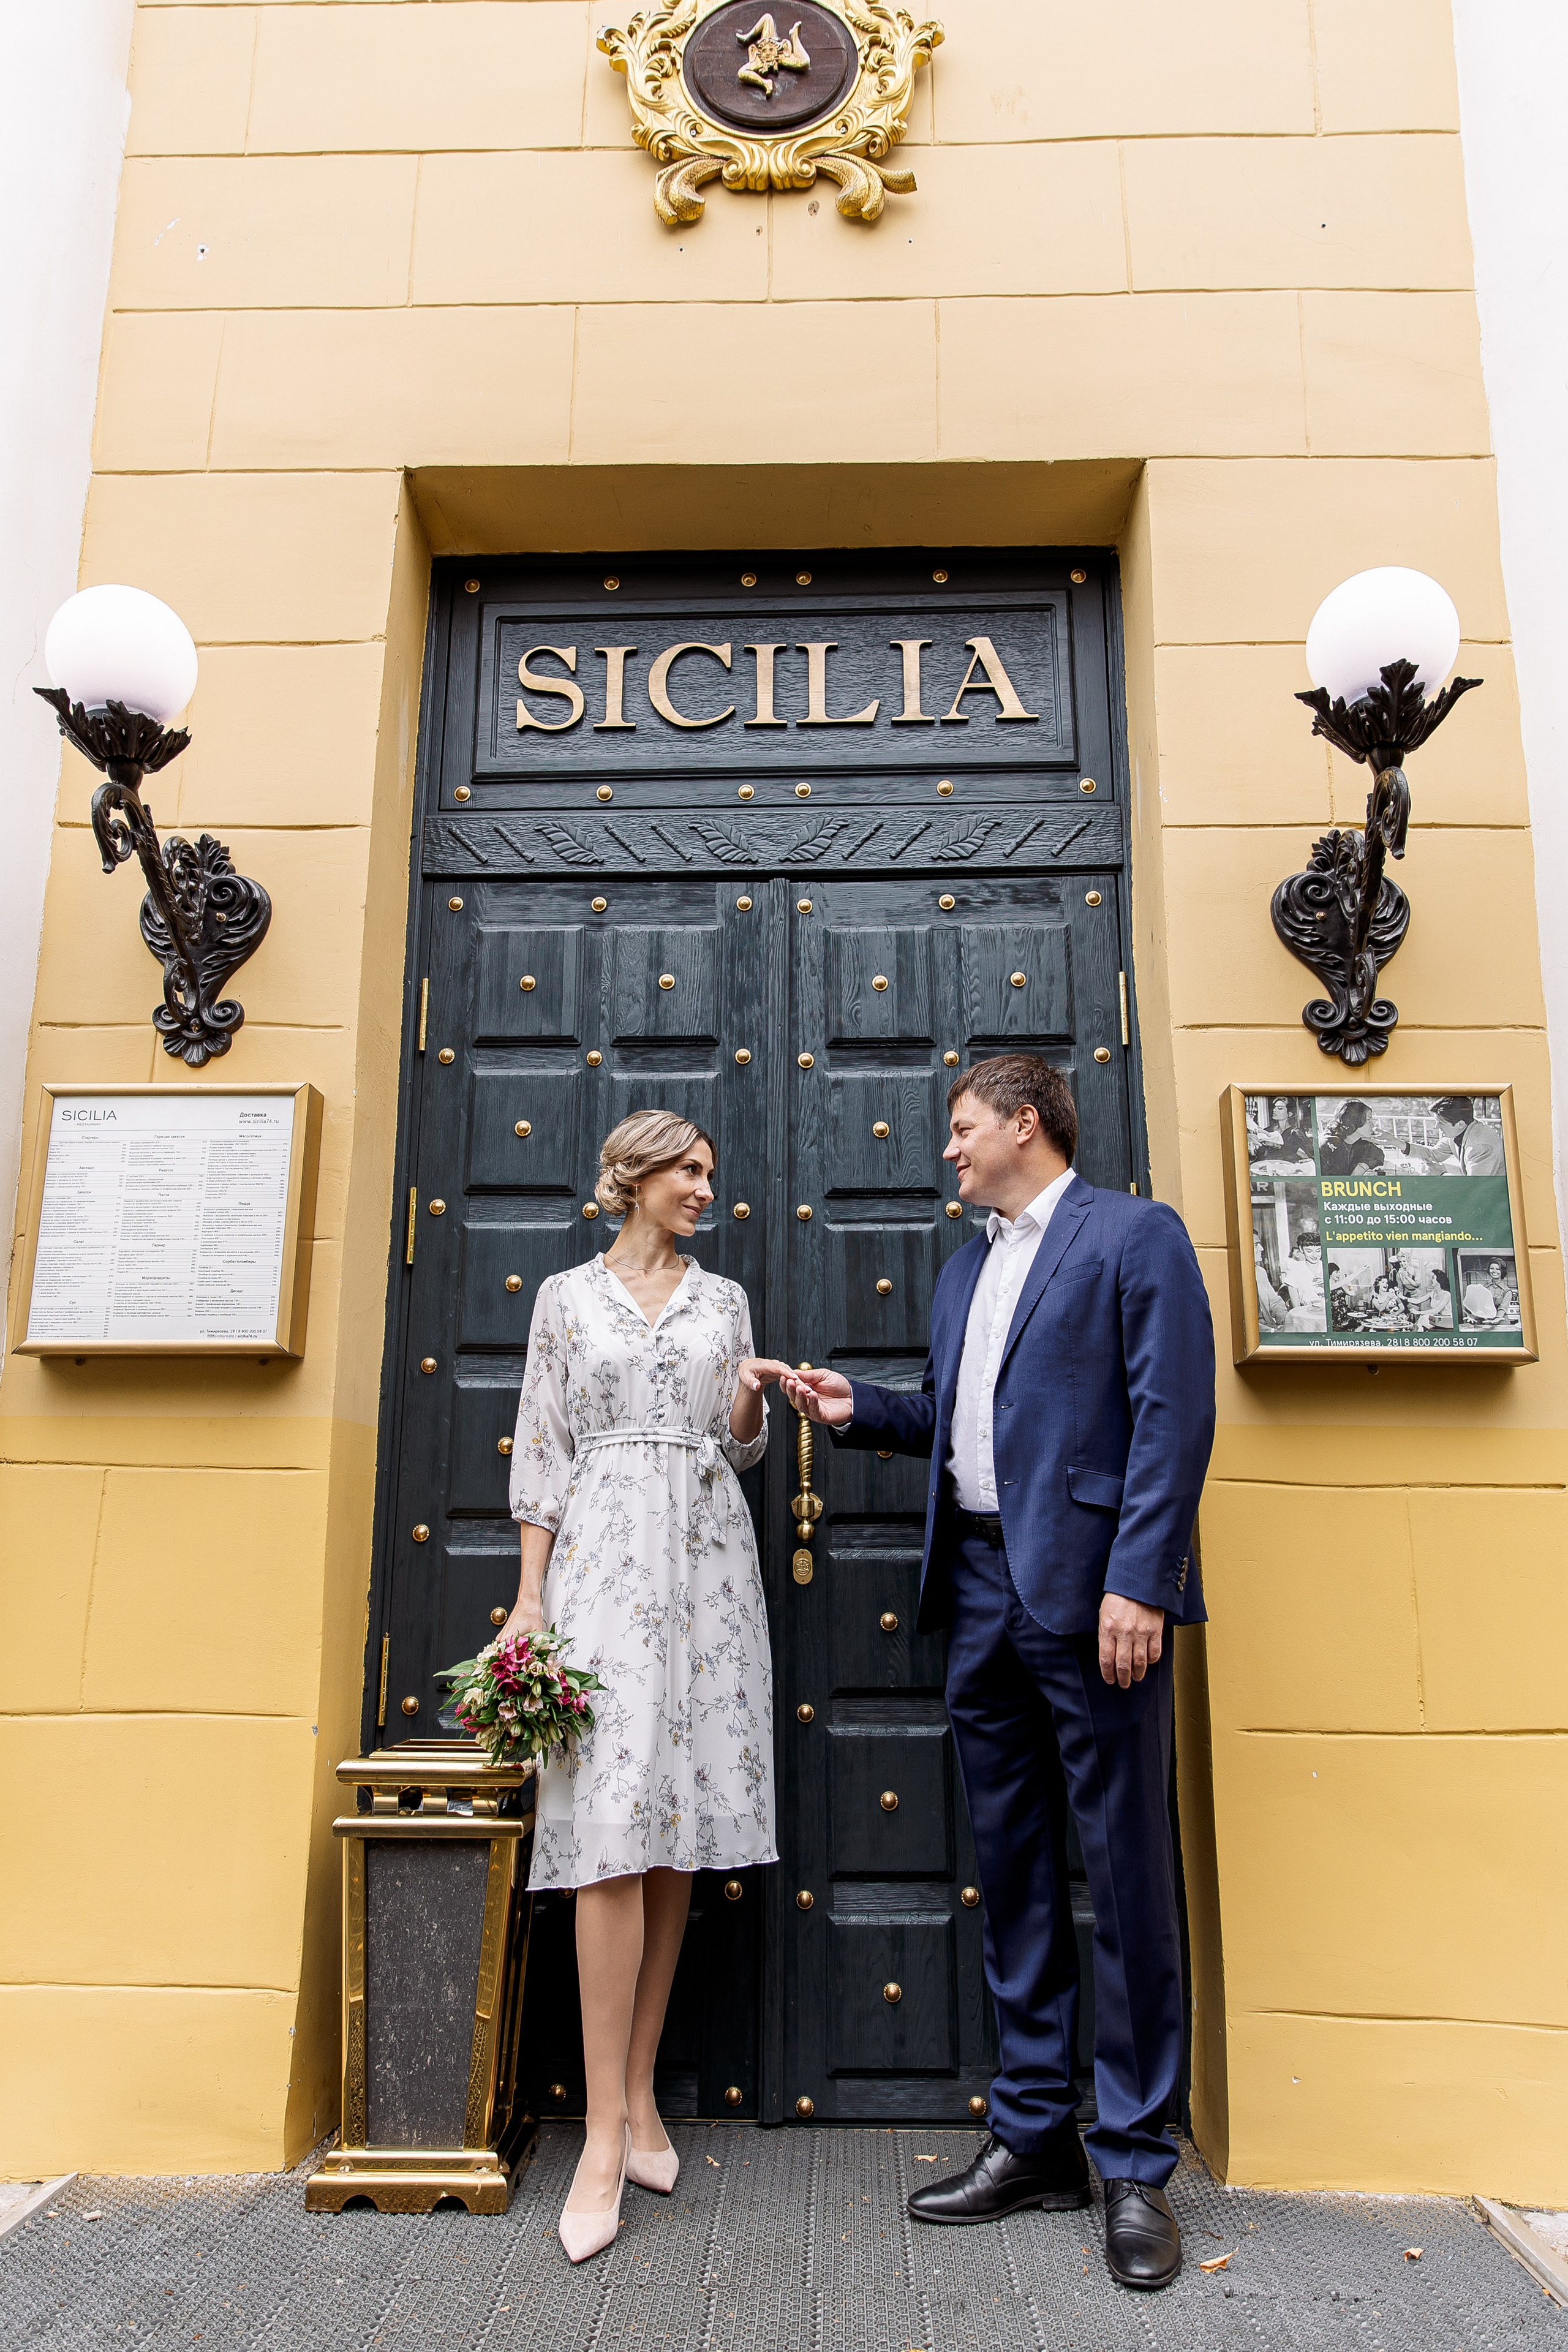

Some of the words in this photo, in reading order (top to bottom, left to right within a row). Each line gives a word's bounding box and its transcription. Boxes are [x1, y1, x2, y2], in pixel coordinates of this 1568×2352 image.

[516, 636, 1039, 730] SICILIA
[61, 1110, 117, 1121] SICILIA
[1321, 1182, 1401, 1197] BRUNCH
[1324, 1202, 1371, 1212] Каждые
[1374, 1204, 1433, 1212] выходные
[1335, 1215, 1363, 1224] 11:00
[1367, 1216, 1381, 1225] до
[1384, 1214, 1415, 1224] 15:00
[1326, 1231, 1383, 1243] L'appetito
[1385, 1231, 1409, 1240] vien
[1412, 1231, 1483, 1243] mangiando...
